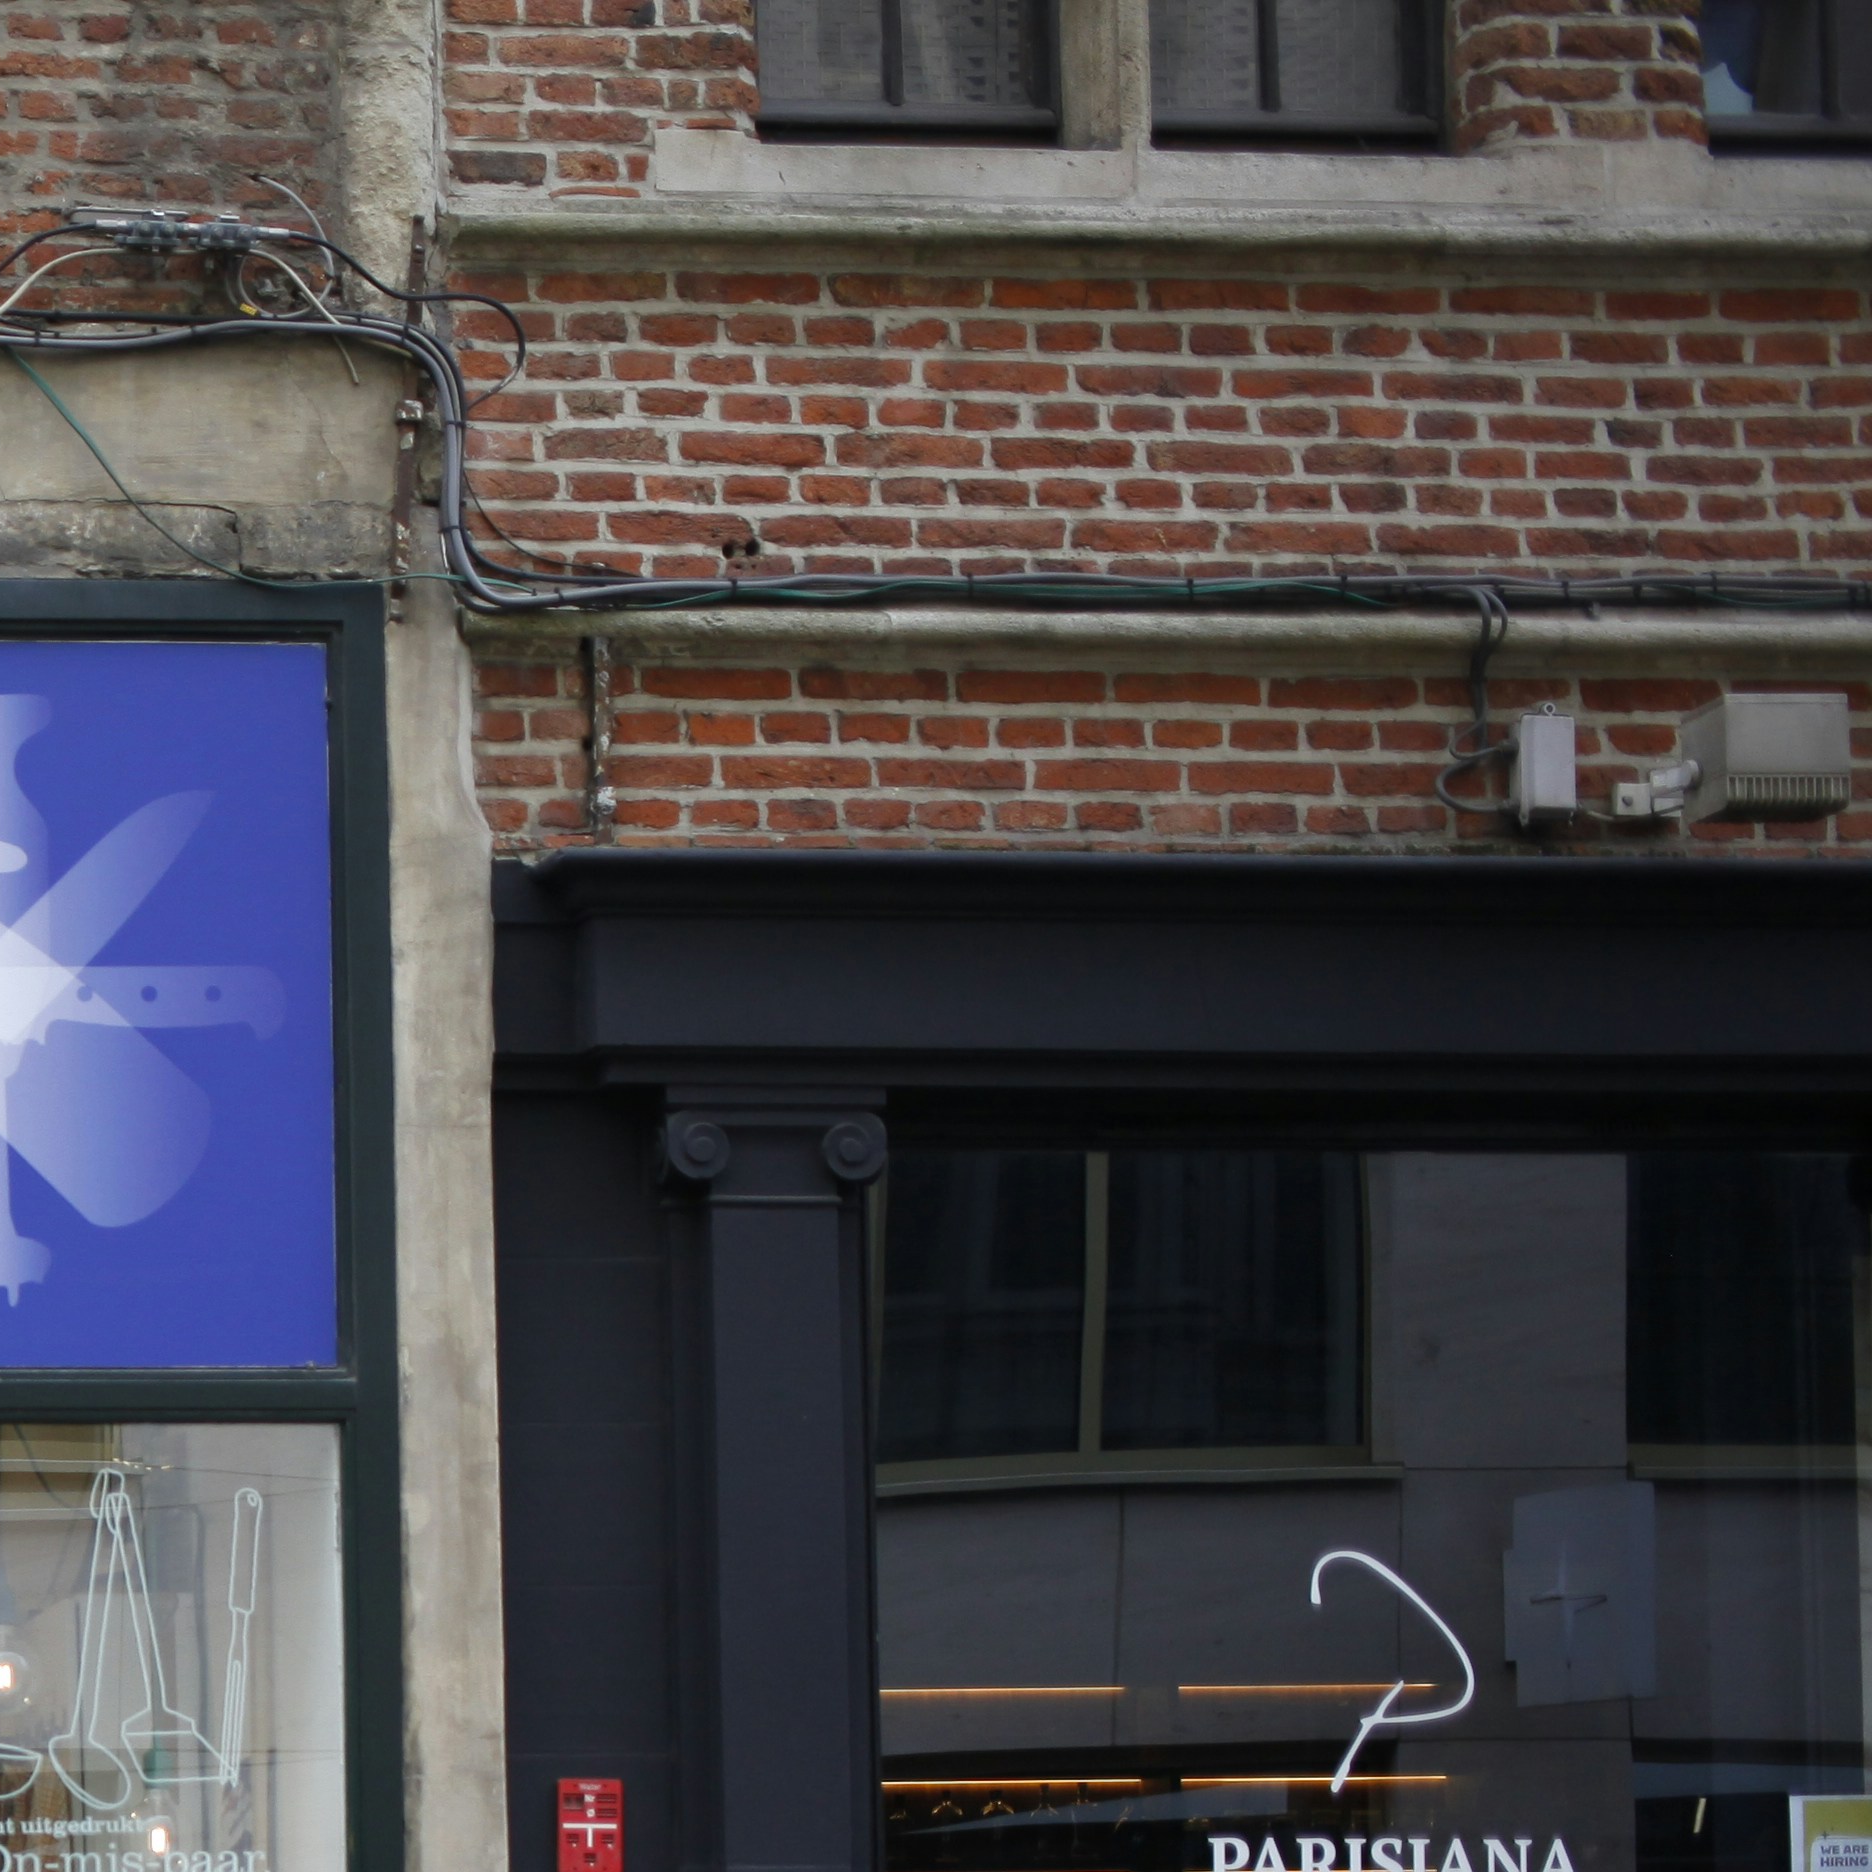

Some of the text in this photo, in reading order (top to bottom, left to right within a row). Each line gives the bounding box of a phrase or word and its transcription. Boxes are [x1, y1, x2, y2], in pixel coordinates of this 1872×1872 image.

[1820, 1844, 1869, 1855] WE ARE
[1820, 1856, 1869, 1867] HIRING
